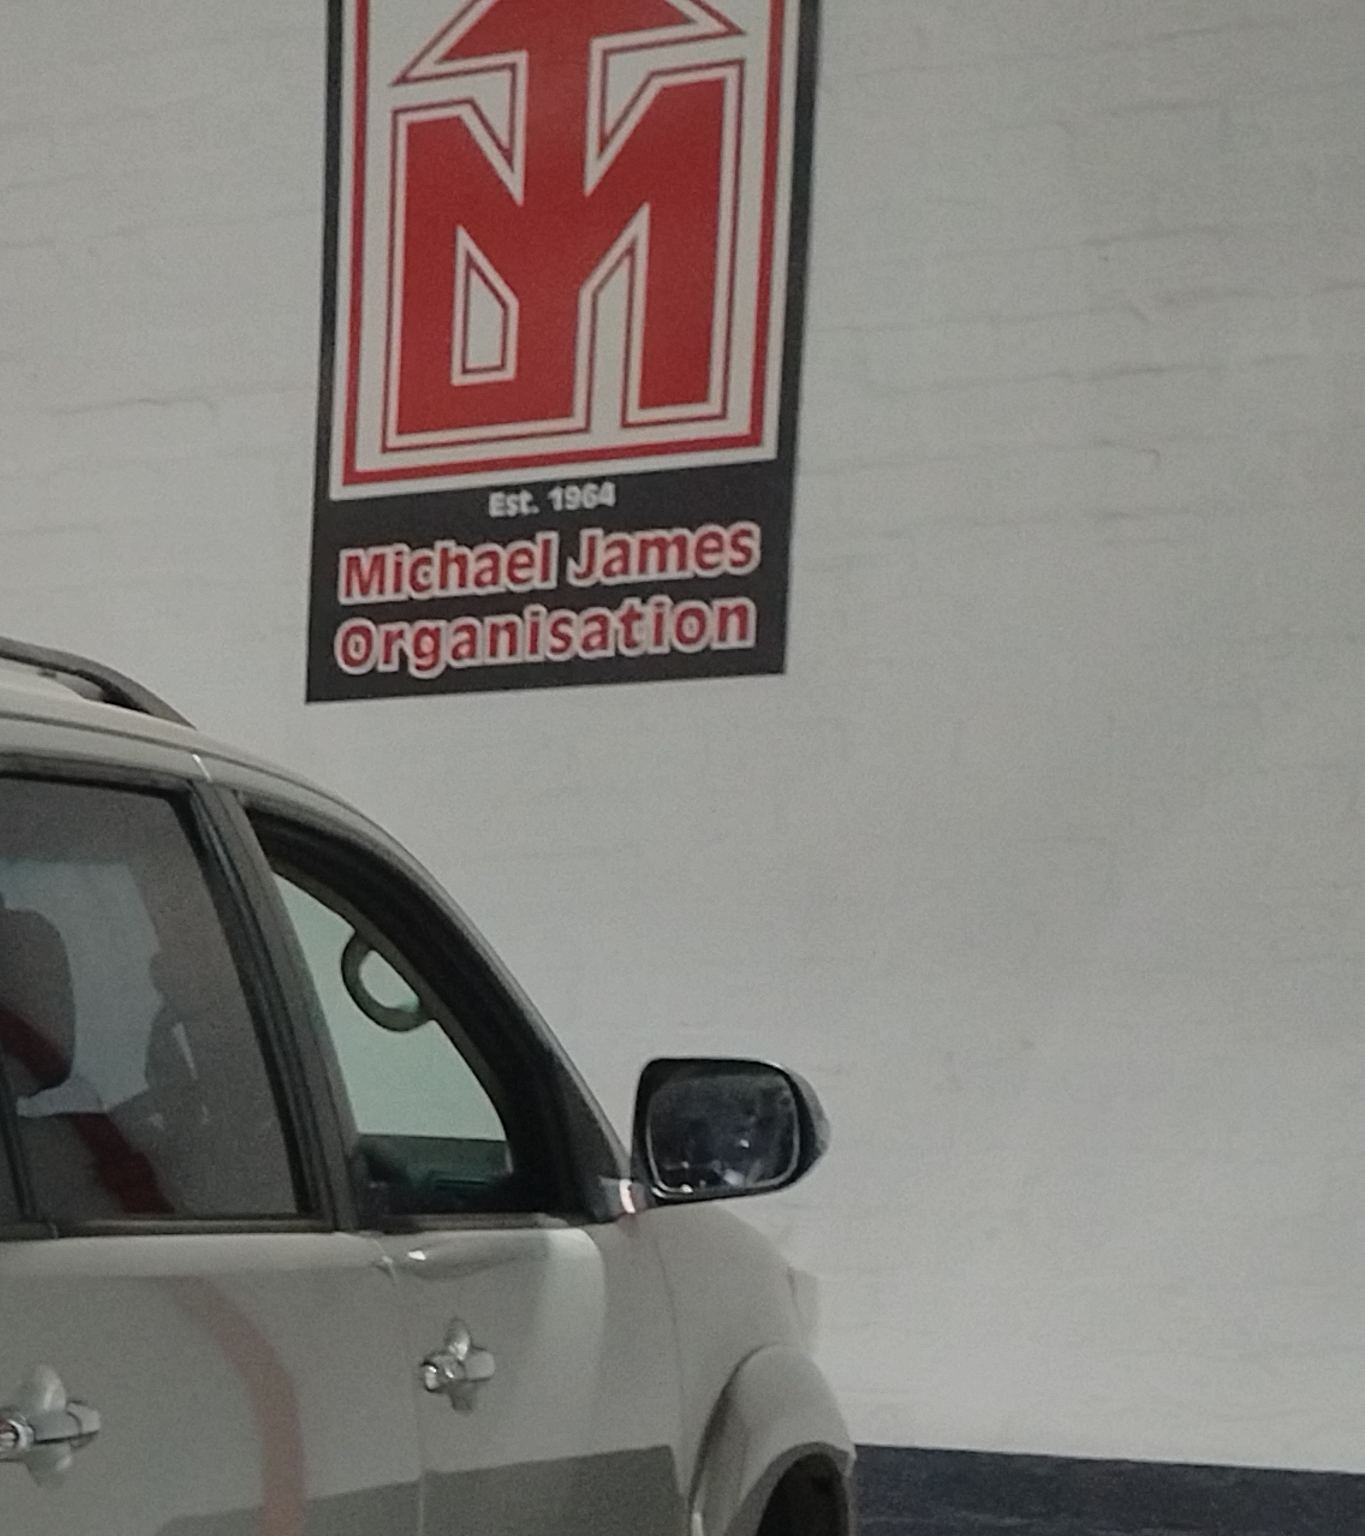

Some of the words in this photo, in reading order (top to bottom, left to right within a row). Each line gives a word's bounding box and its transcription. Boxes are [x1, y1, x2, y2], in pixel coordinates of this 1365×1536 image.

[487, 490, 540, 518] Est.
[548, 481, 618, 512] 1964
[337, 529, 559, 605] Michael
[568, 519, 761, 587] James
[333, 594, 758, 678] Organisation
